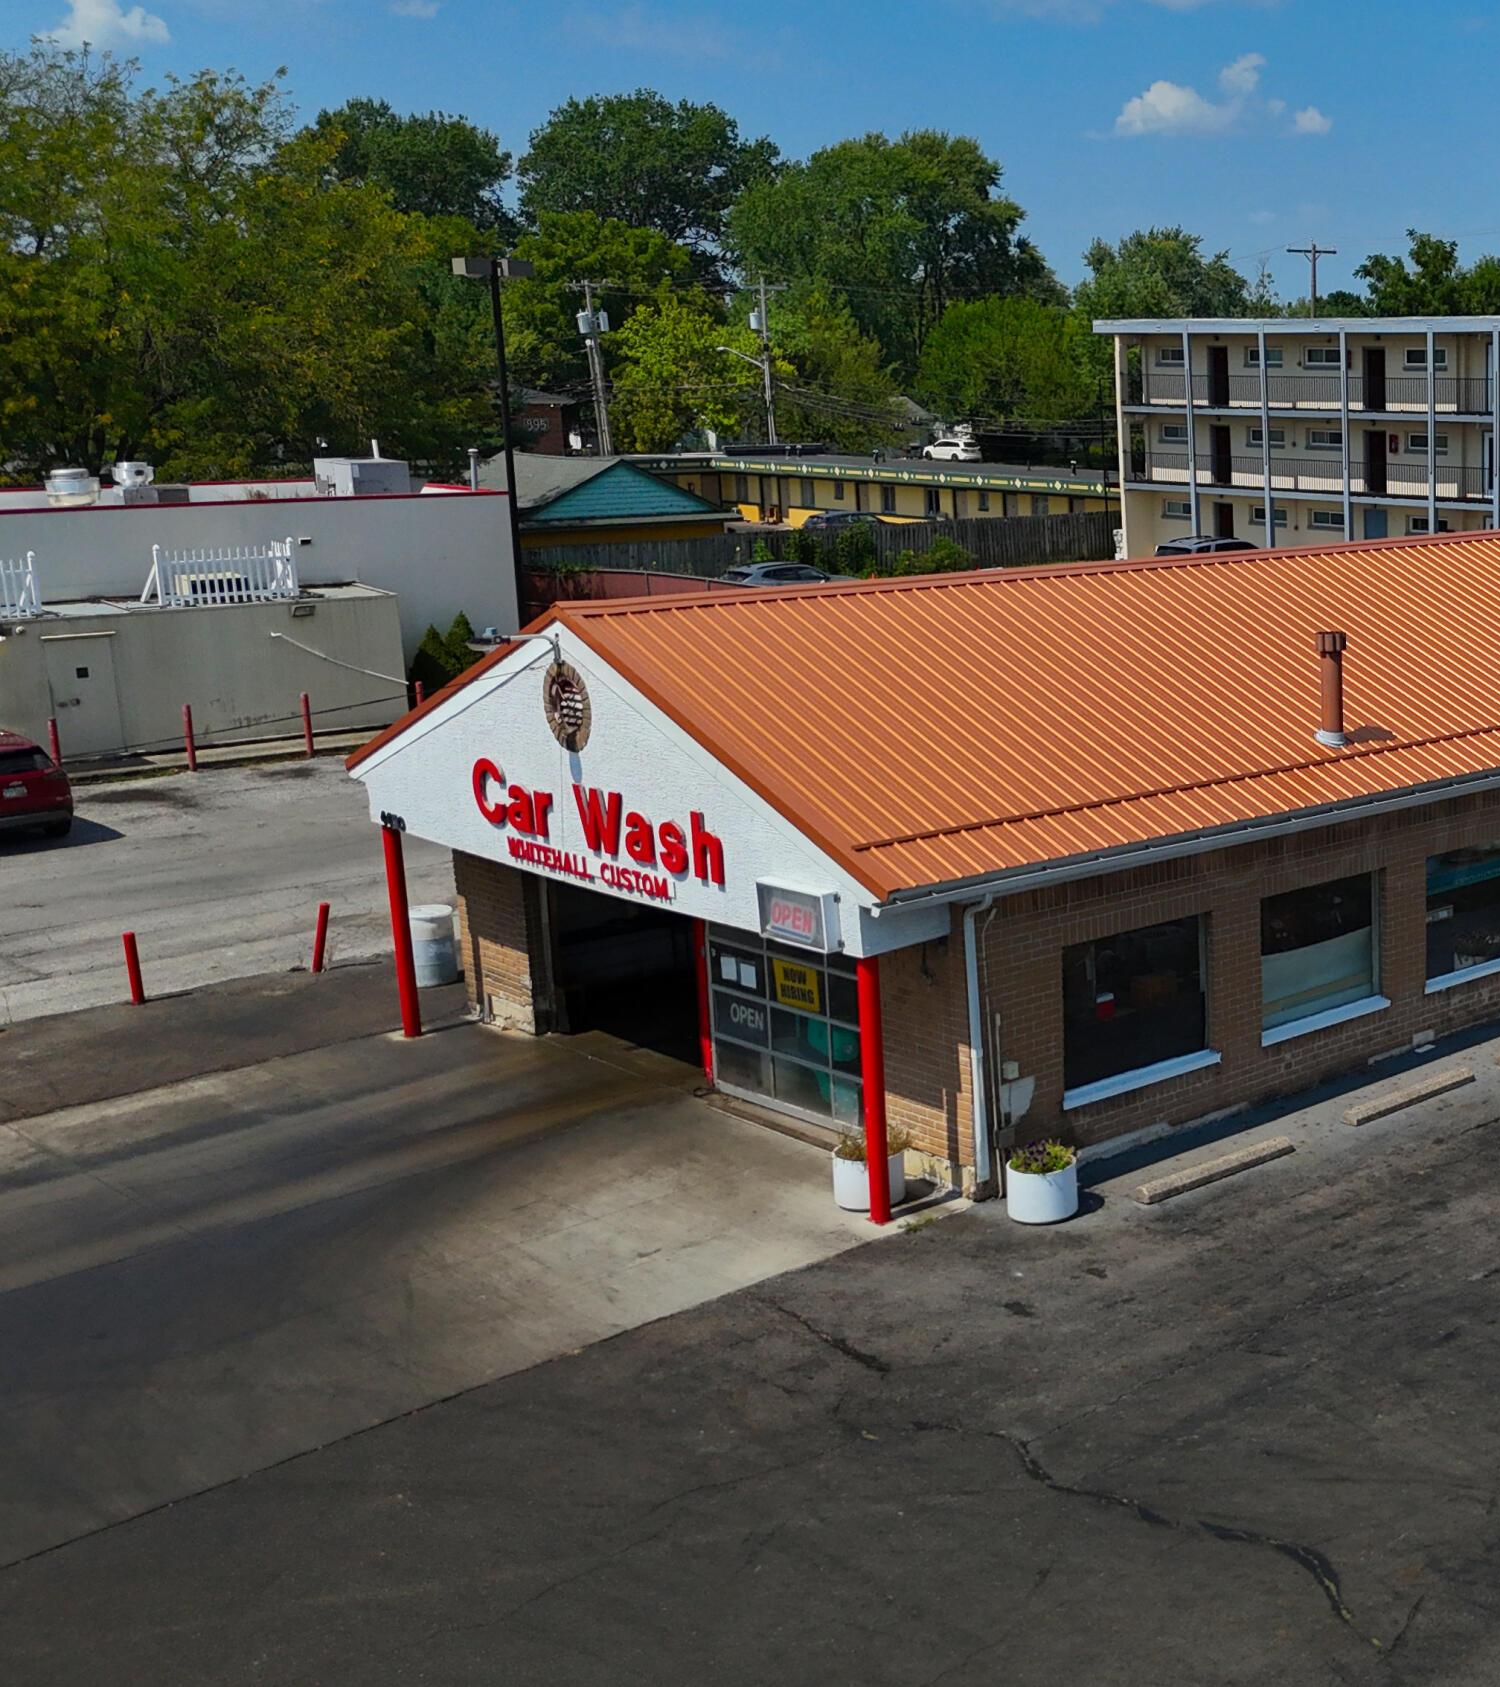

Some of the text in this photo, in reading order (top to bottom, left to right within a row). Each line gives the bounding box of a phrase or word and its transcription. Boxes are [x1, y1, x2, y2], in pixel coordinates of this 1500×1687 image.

[472, 757, 726, 886] Car Wash
[507, 836, 672, 901] WHITEHALL CUSTOM
[771, 901, 814, 934] OPEN
[782, 966, 807, 985] NOW
[780, 982, 815, 1004] HIRING
[730, 1002, 764, 1031] OPEN
